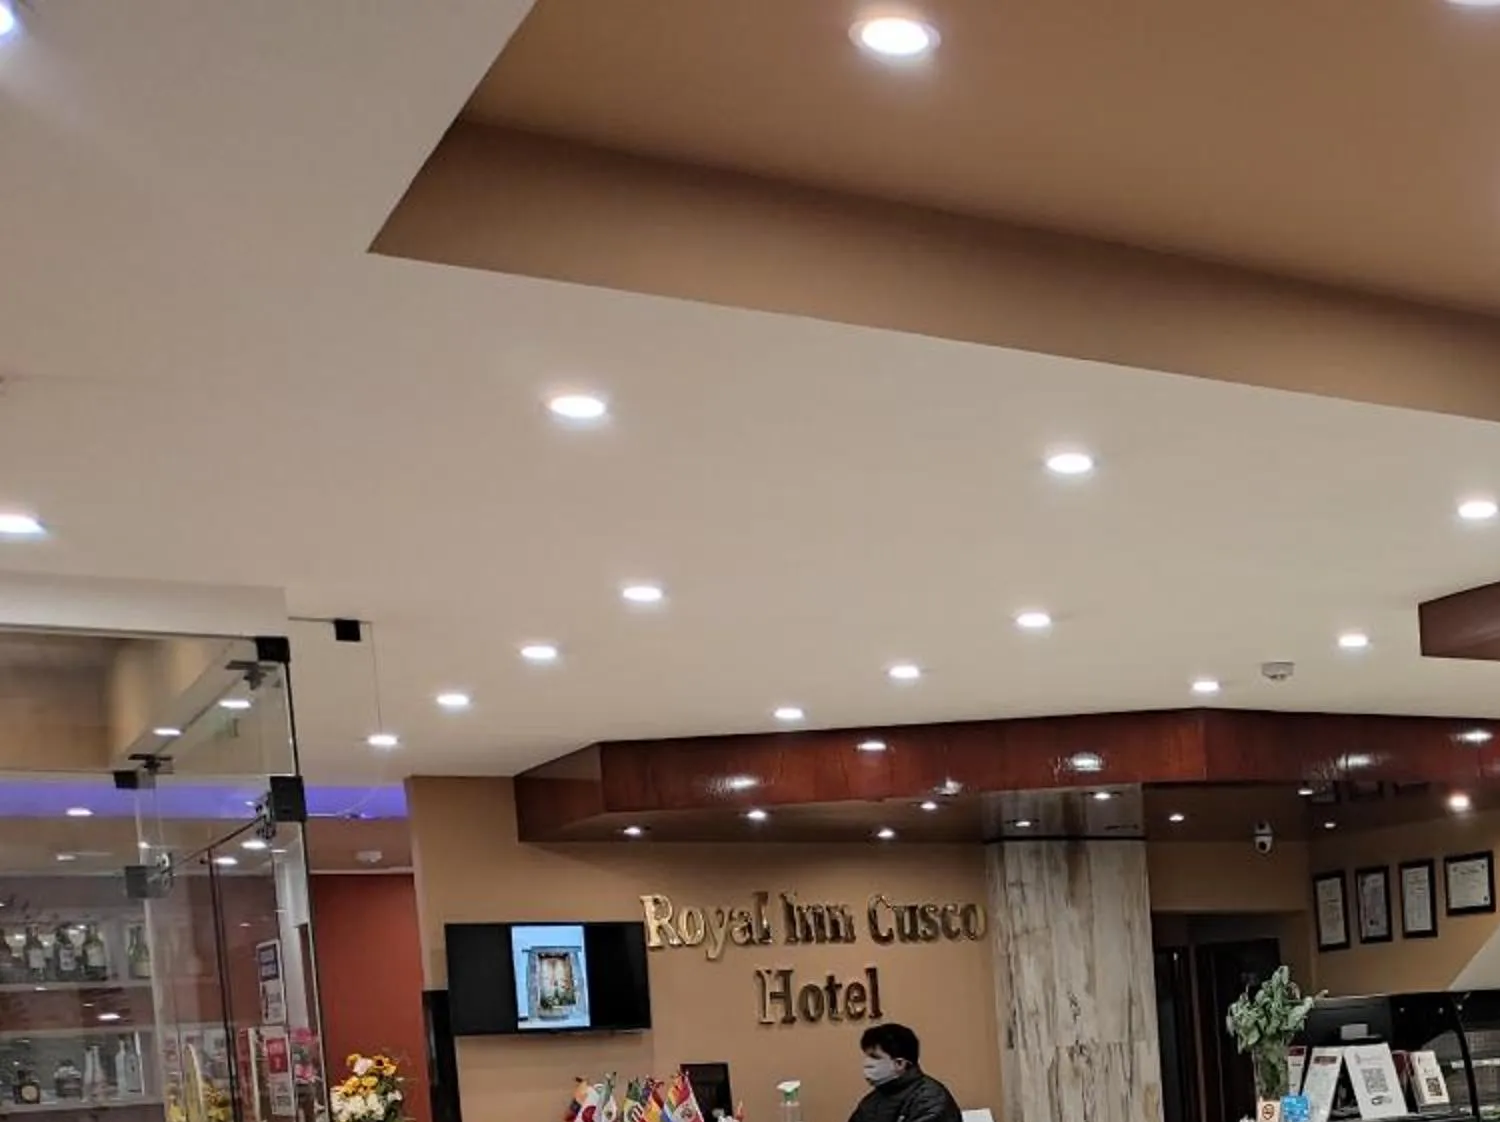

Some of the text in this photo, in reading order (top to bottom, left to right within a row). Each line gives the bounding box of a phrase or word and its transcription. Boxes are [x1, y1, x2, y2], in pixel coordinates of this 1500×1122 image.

[640, 891, 988, 961] Royal Inn Cusco
[756, 967, 883, 1025] Hotel
